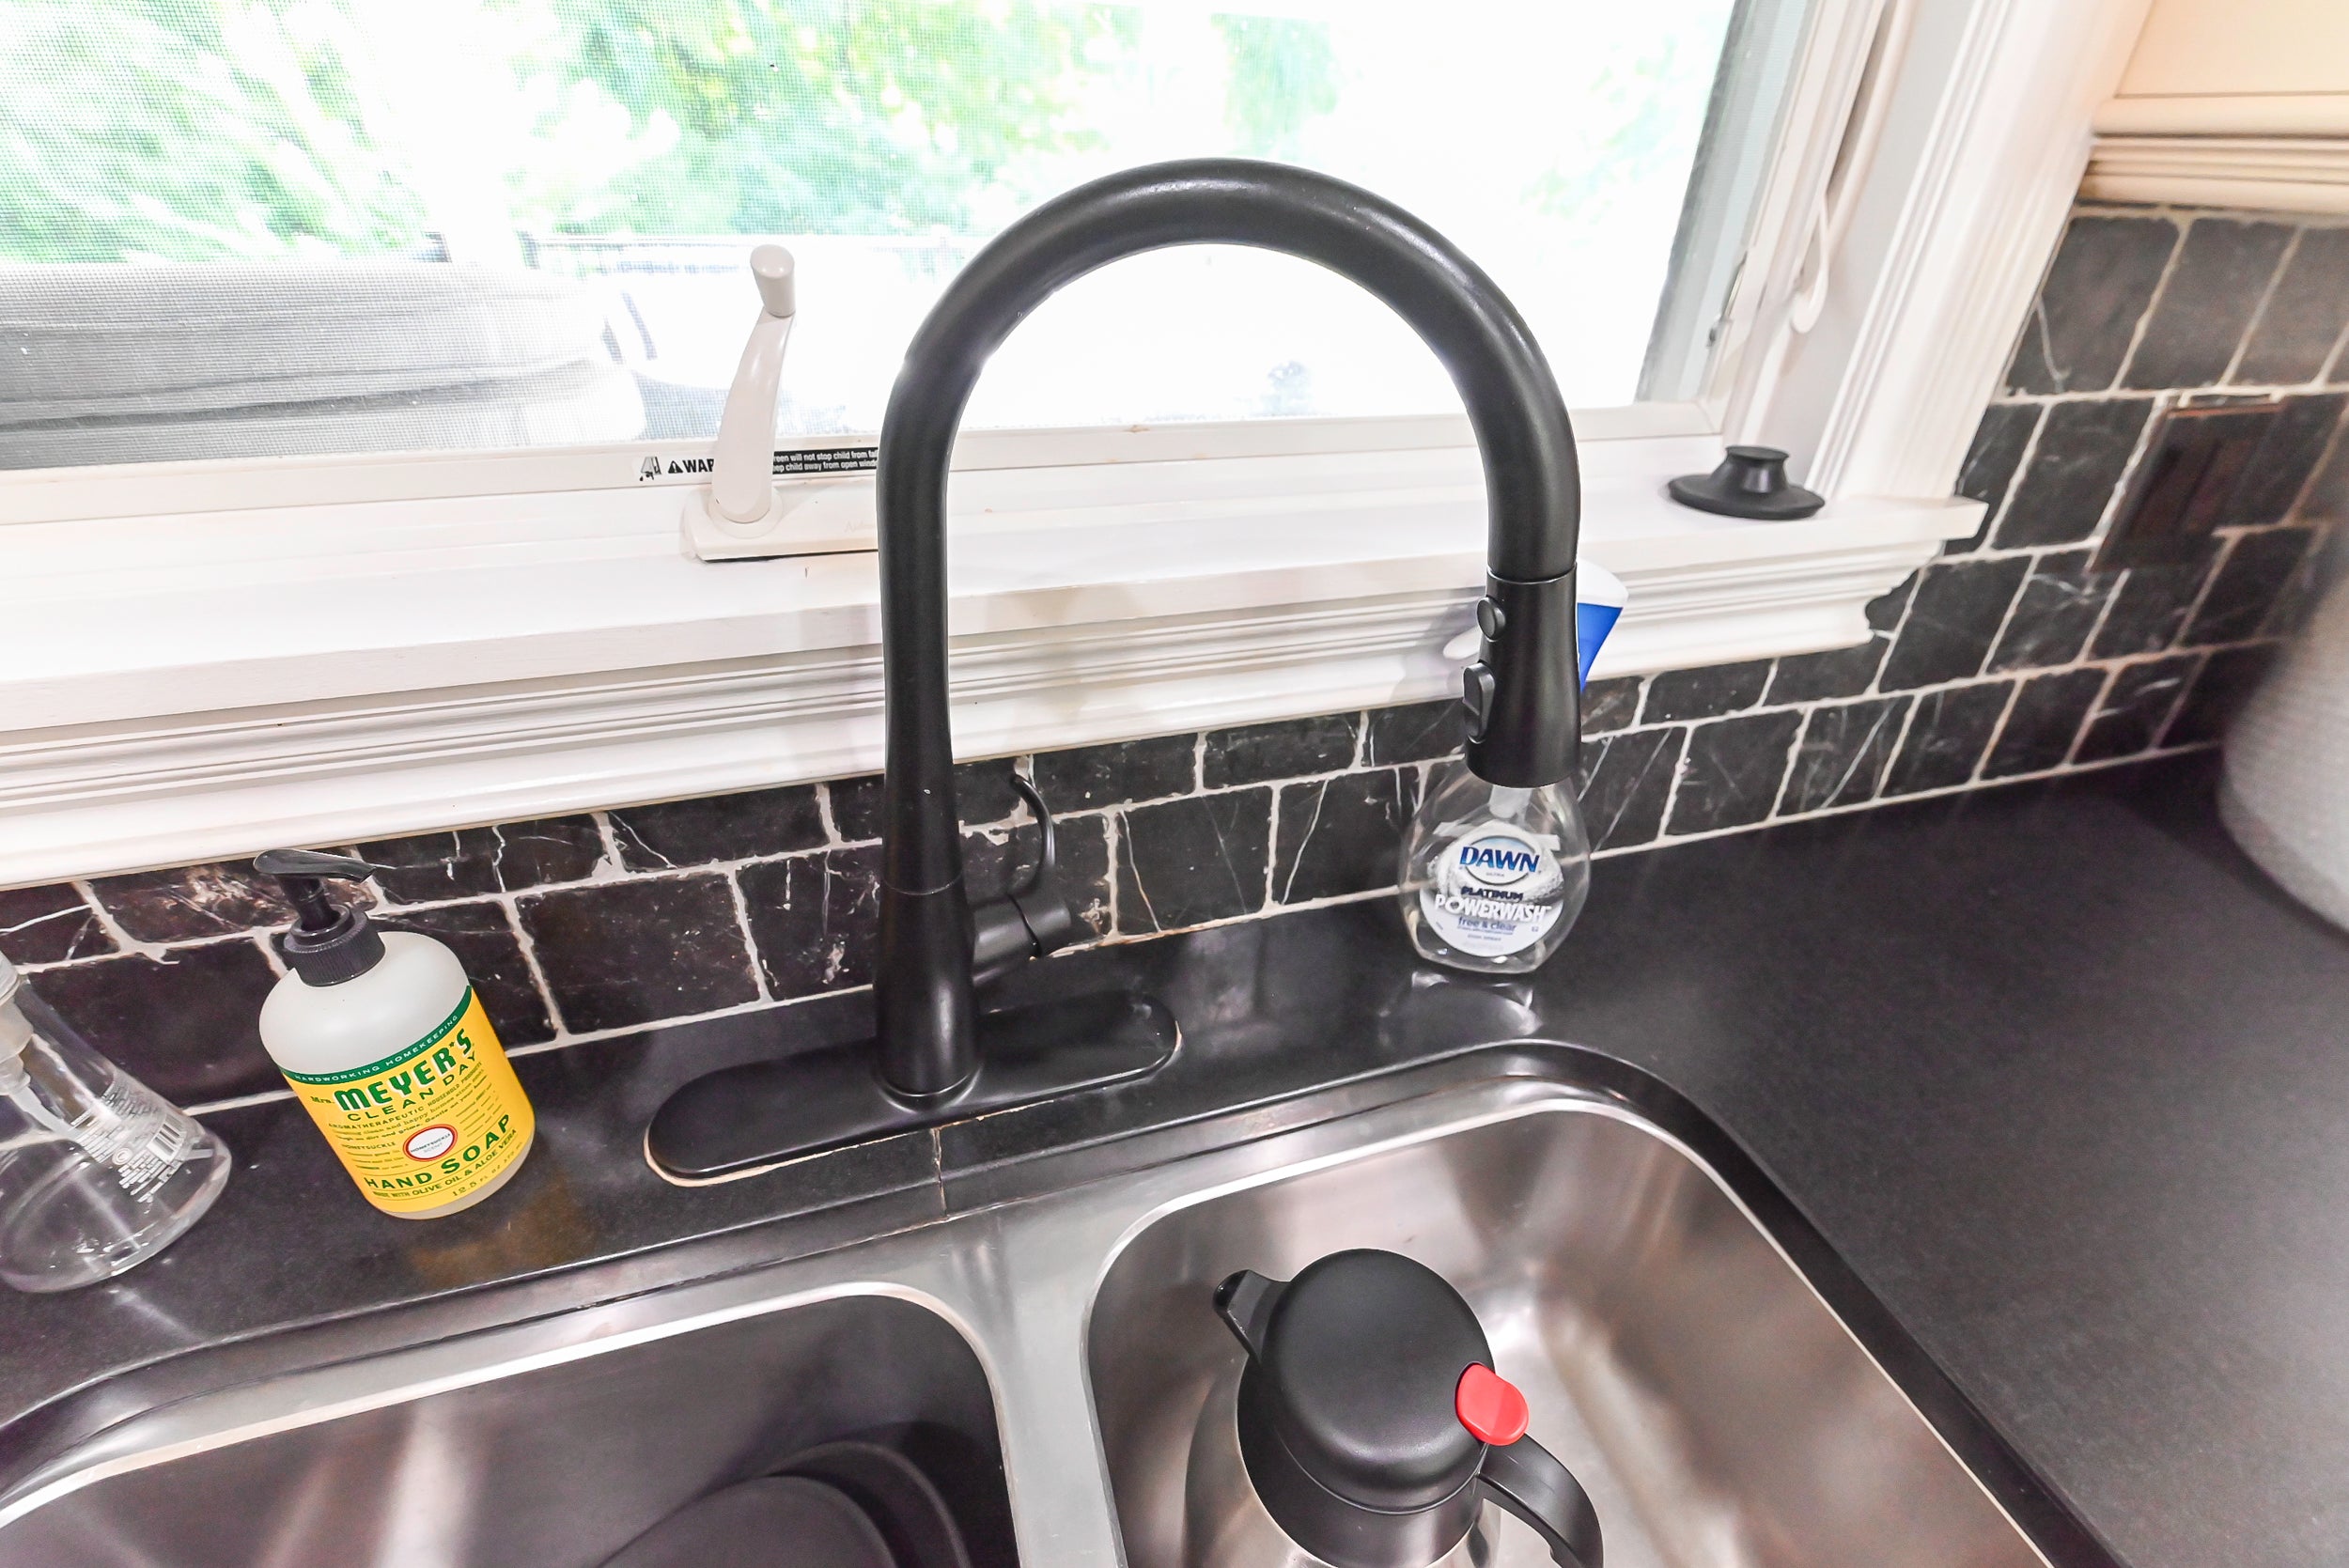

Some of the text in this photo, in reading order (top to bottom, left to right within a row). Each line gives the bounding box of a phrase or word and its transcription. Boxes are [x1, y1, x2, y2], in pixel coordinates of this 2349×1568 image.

[682, 458, 714, 473] WAR
[786, 462, 803, 471] child
[803, 462, 821, 471] away
[822, 460, 840, 469] from
[840, 460, 859, 470] open
[790, 453, 803, 461] will
[817, 452, 832, 461] stop
[833, 451, 850, 459] child
[850, 450, 868, 458] from
[1459, 846, 1540, 873] DAWN
[1461, 886, 1524, 901] PLATINUM
[1458, 916, 1480, 926] free
[1490, 920, 1517, 932] clear
[294, 1015, 459, 1082] HARDWORKING HOMEKEEPING
[347, 1087, 434, 1122] CLEAN
[443, 1050, 475, 1086] DAY
[364, 1172, 432, 1189] HAND
[441, 1114, 509, 1174] SOAP
[412, 1184, 443, 1196] OLIVE
[444, 1175, 463, 1186] OIL
[474, 1149, 498, 1170] ALOE
[498, 1128, 517, 1149] VERA
